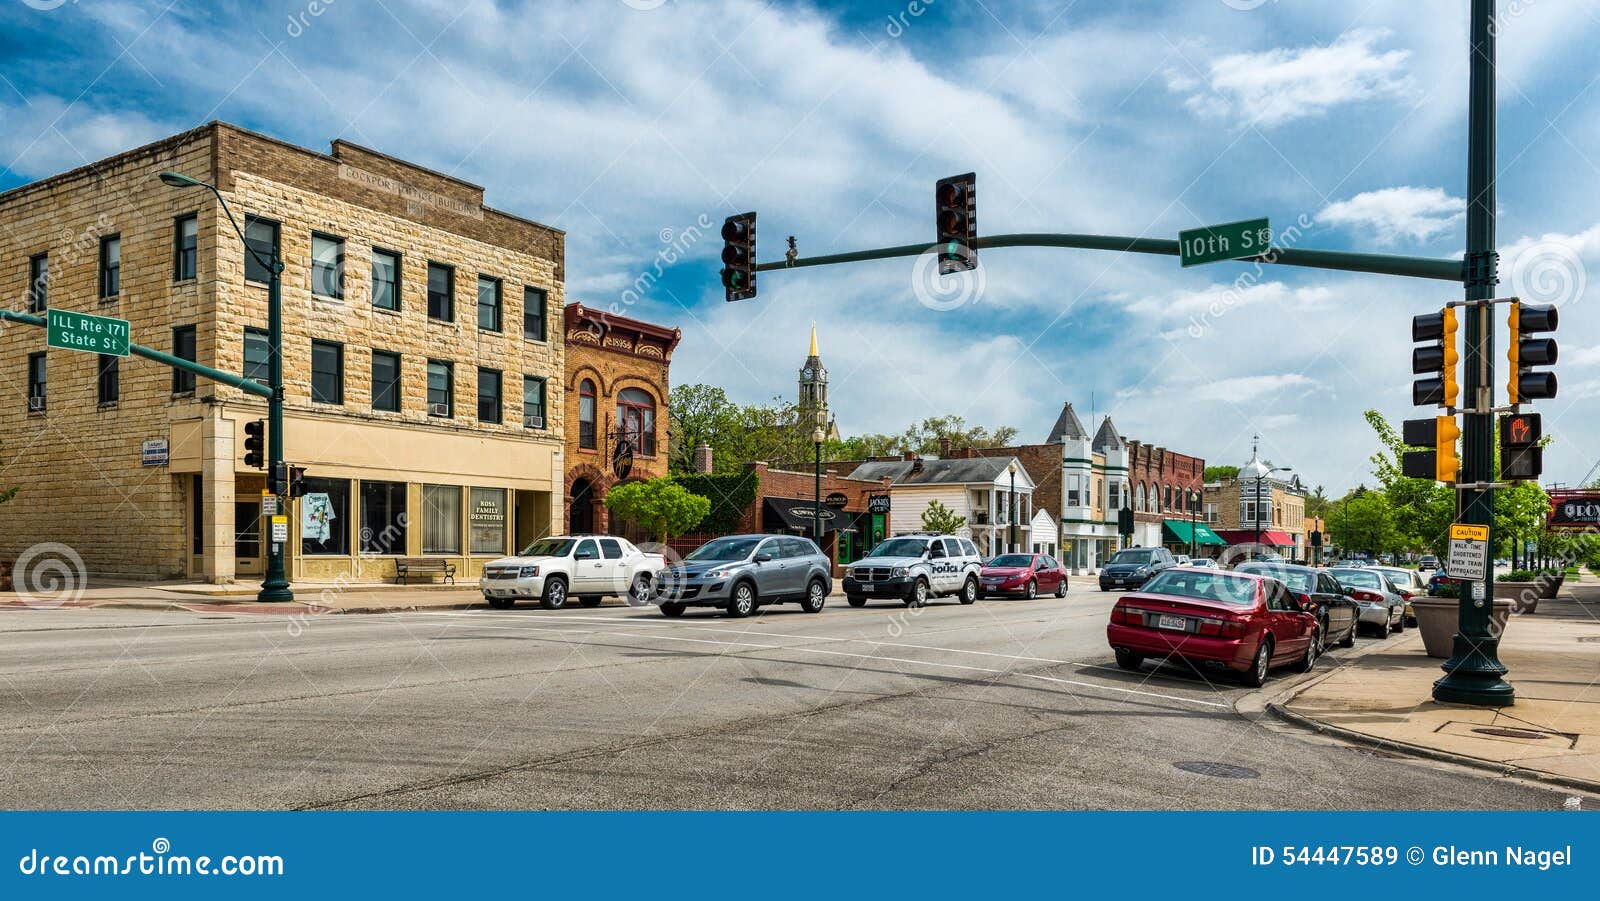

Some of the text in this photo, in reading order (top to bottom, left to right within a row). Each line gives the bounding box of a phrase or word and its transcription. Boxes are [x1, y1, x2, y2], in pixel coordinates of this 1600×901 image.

[346, 167, 395, 193] LOCKPORT
[438, 196, 479, 217] BUILDING
[1184, 228, 1264, 258] 10th St
[53, 314, 126, 337] ILL Rte 171
[61, 331, 118, 350] State St
[1456, 529, 1482, 537] CAUTION
[1453, 551, 1482, 559] SHORTENED
[931, 564, 959, 574] POLICE
[1450, 567, 1483, 576] APPROACHES
